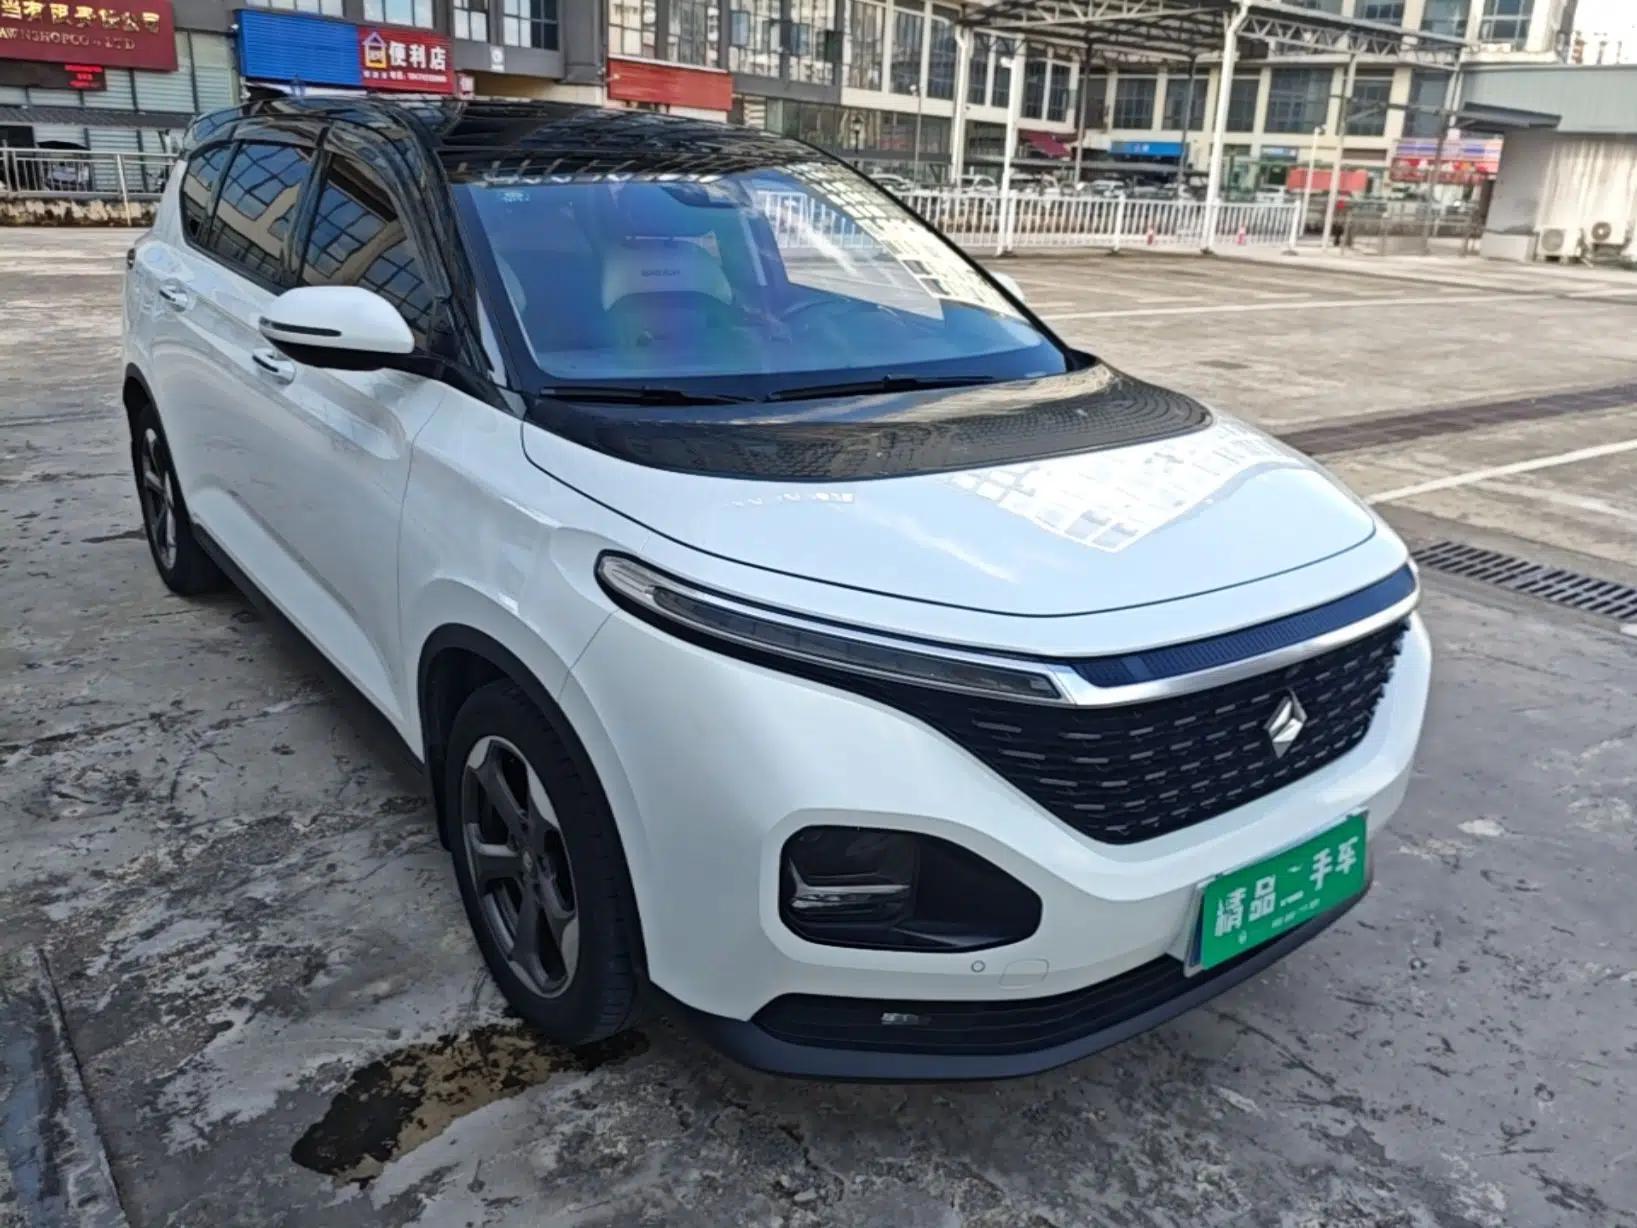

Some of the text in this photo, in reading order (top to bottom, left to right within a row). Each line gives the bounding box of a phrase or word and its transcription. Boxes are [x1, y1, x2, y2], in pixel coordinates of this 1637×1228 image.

[389, 40, 446, 71] 便利店
[1215, 836, 1359, 936] 精品二手车
